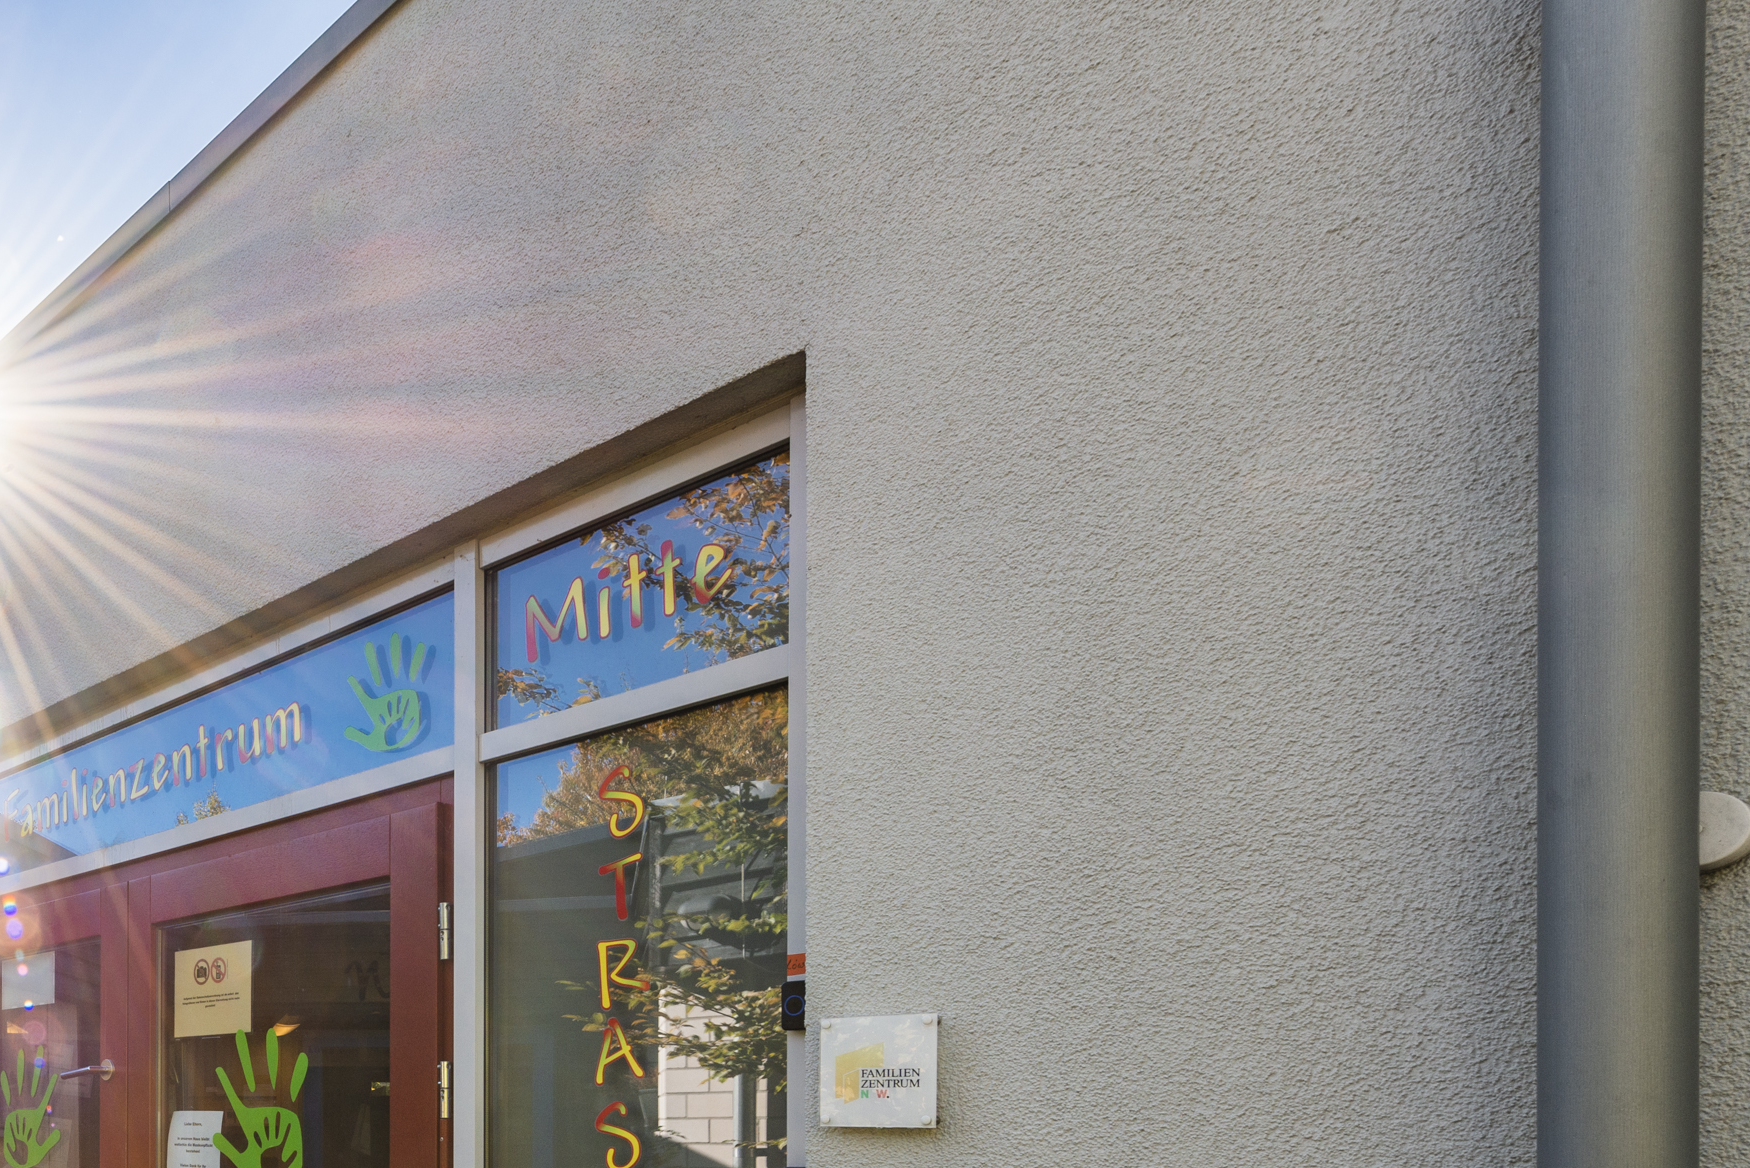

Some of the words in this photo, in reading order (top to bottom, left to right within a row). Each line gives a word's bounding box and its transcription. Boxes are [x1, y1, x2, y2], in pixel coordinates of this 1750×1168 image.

[525, 539, 734, 663] Mitte
[4, 701, 301, 843] Familienzentrum
[860, 1078, 920, 1089] ZENTRUM
[861, 1068, 920, 1078] FAMILIEN
